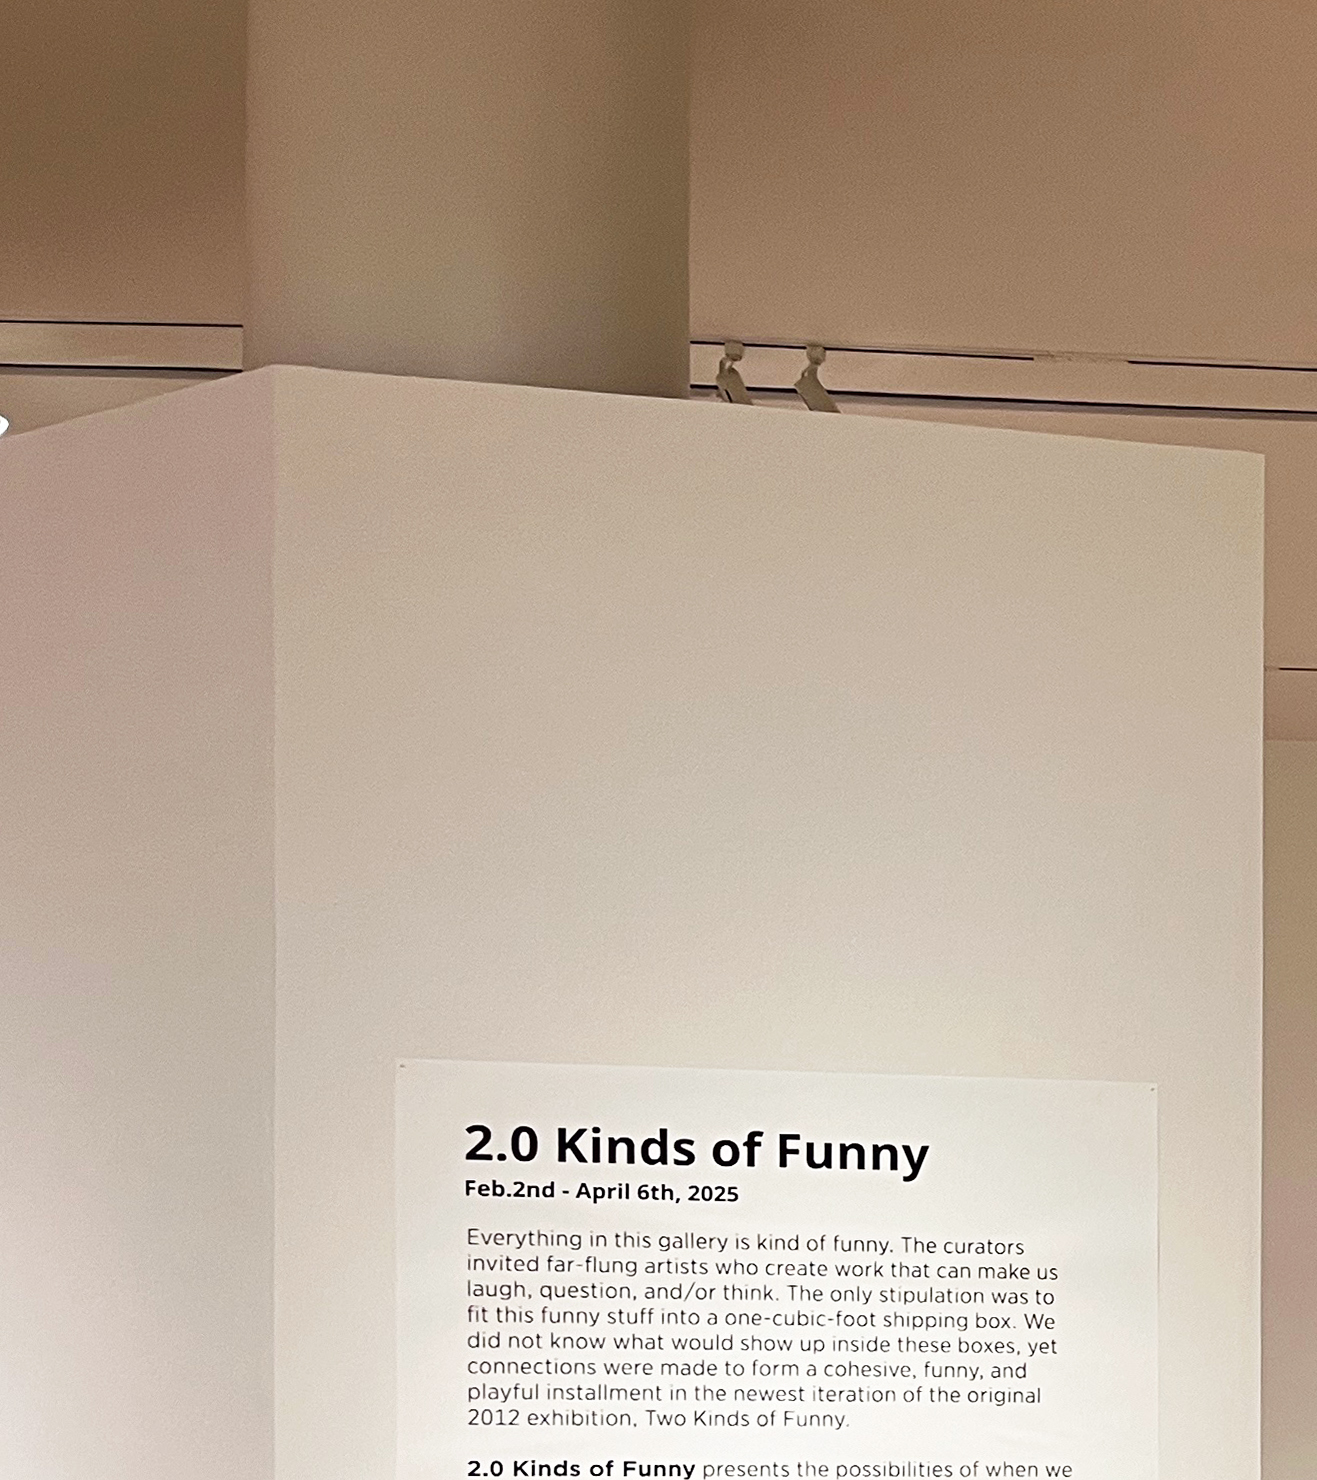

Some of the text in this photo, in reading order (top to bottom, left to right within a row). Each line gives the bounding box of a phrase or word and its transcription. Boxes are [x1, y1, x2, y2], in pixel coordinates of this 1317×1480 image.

[464, 1124, 930, 1183] 2.0 Kinds of Funny
[464, 1178, 555, 1199] Feb.2nd
[575, 1182, 630, 1205] April
[636, 1183, 681, 1205] 6th,
[687, 1184, 739, 1203] 2025
[467, 1227, 1025, 1256] Everything in this gallery is kind of funny. The curators
[467, 1253, 1059, 1281] invited far-flung artists who create work that can make us
[467, 1279, 1055, 1306] laugh, question, and/or think. The only stipulation was to
[467, 1304, 1056, 1332] fit this funny stuff into a one-cubic-foot shipping box. We
[467, 1330, 1058, 1358] did not know what would show up inside these boxes, yet
[467, 1358, 1027, 1382] connections were made to form a cohesive, funny, and
[467, 1382, 1041, 1407] playful installment in the newest iteration of the original
[467, 1459, 1073, 1480] 2.0 Kinds of Funny presents the possibilities of when we
